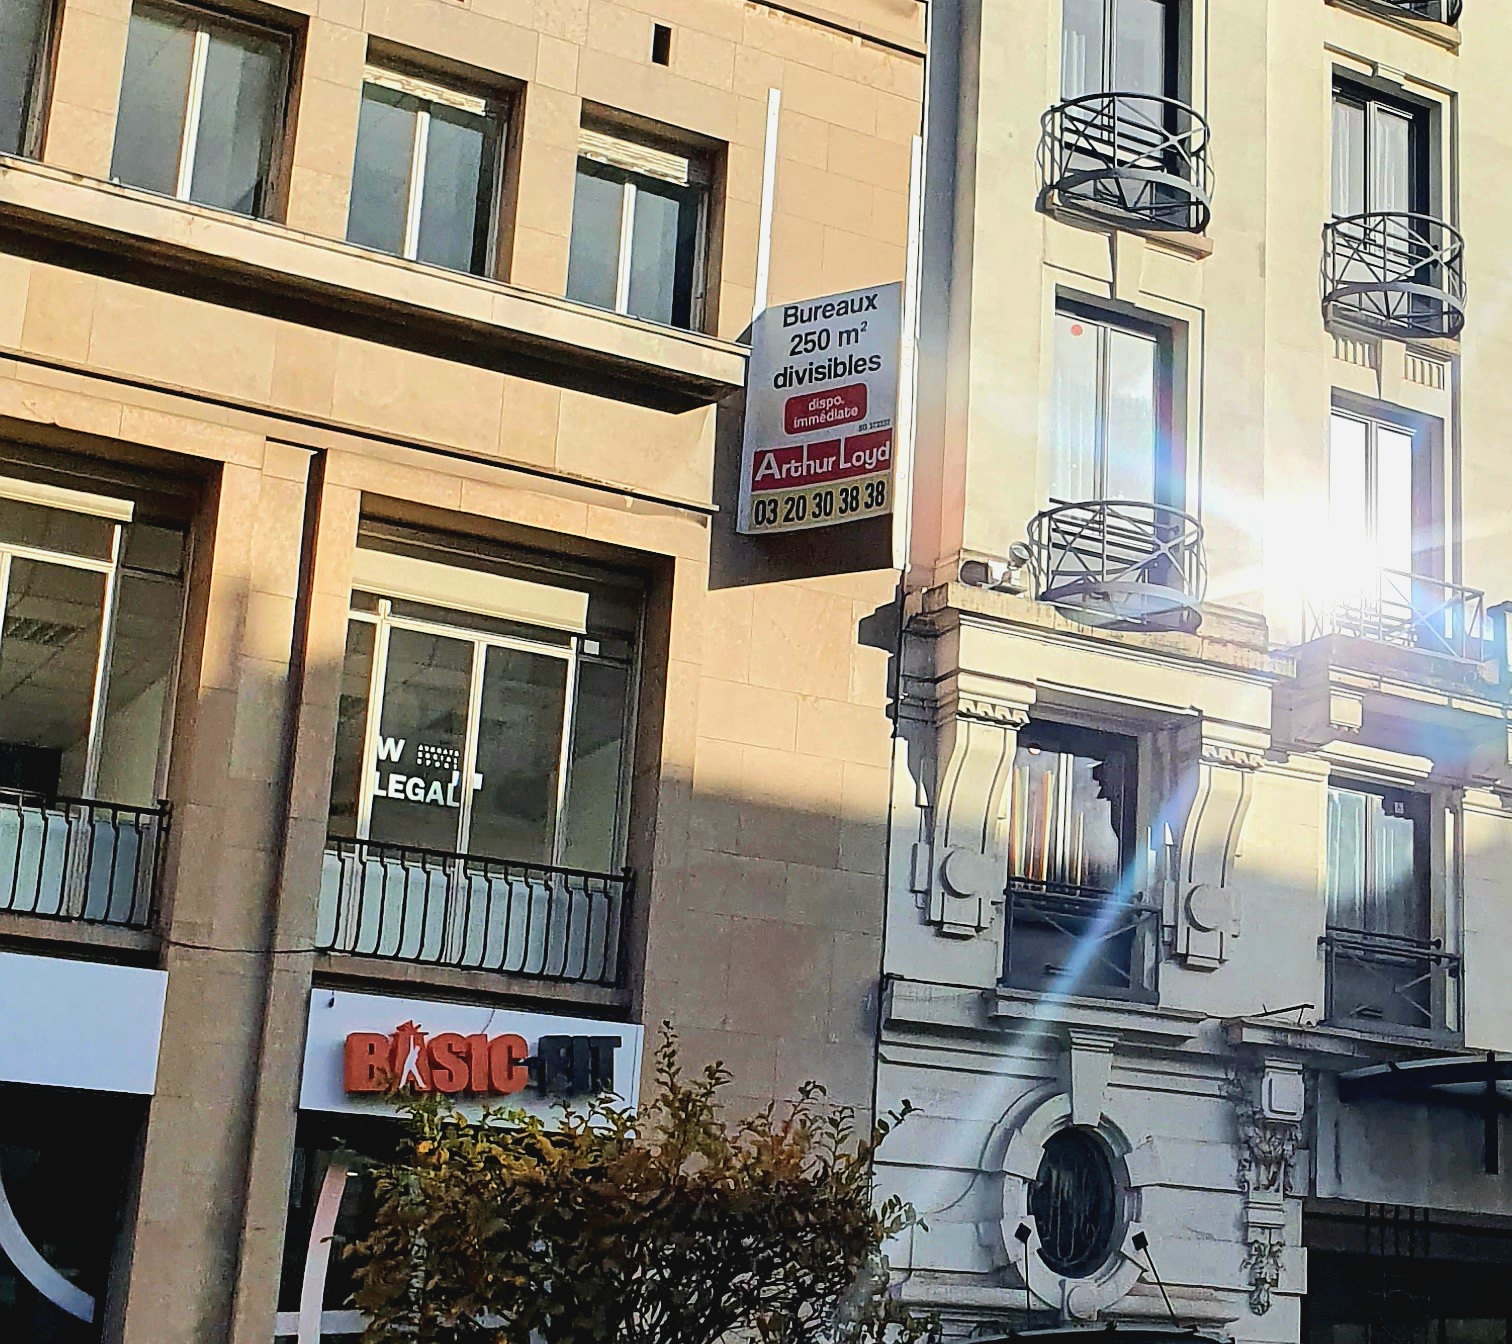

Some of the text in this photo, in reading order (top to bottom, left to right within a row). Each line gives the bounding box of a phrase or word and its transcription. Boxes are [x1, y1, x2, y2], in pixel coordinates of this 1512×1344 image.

[782, 293, 879, 328] Bureaux
[789, 328, 831, 356] 250
[773, 354, 882, 390] divisibles
[808, 395, 845, 411] dispo.
[754, 438, 890, 481] Arthur Loyd
[754, 480, 886, 526] 03 20 30 38 38
[376, 735, 406, 763] W
[372, 771, 461, 807] LEGAL
